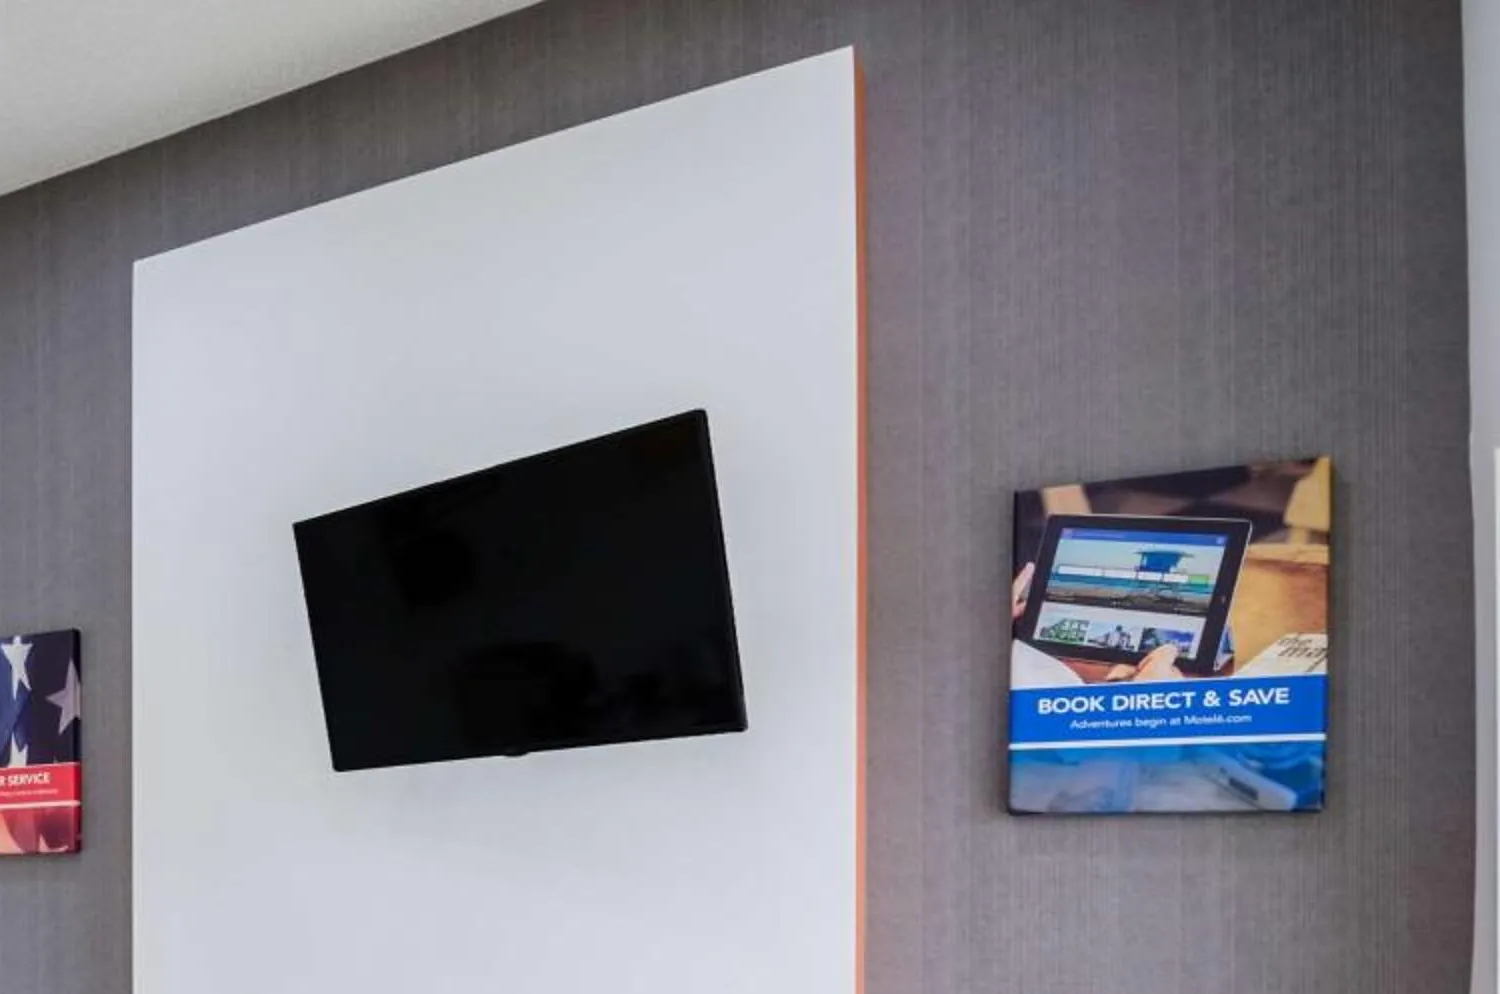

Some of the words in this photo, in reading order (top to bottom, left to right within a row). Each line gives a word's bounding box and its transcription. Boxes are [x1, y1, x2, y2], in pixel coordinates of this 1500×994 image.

[1038, 696, 1105, 715] BOOK
[1112, 691, 1196, 711] DIRECT
[1203, 690, 1220, 707] &
[1228, 687, 1290, 707] SAVE
[1069, 718, 1133, 730] Adventures
[1134, 717, 1167, 730] begin
[1169, 717, 1181, 726] at
[8, 772, 51, 787] SERVICE
